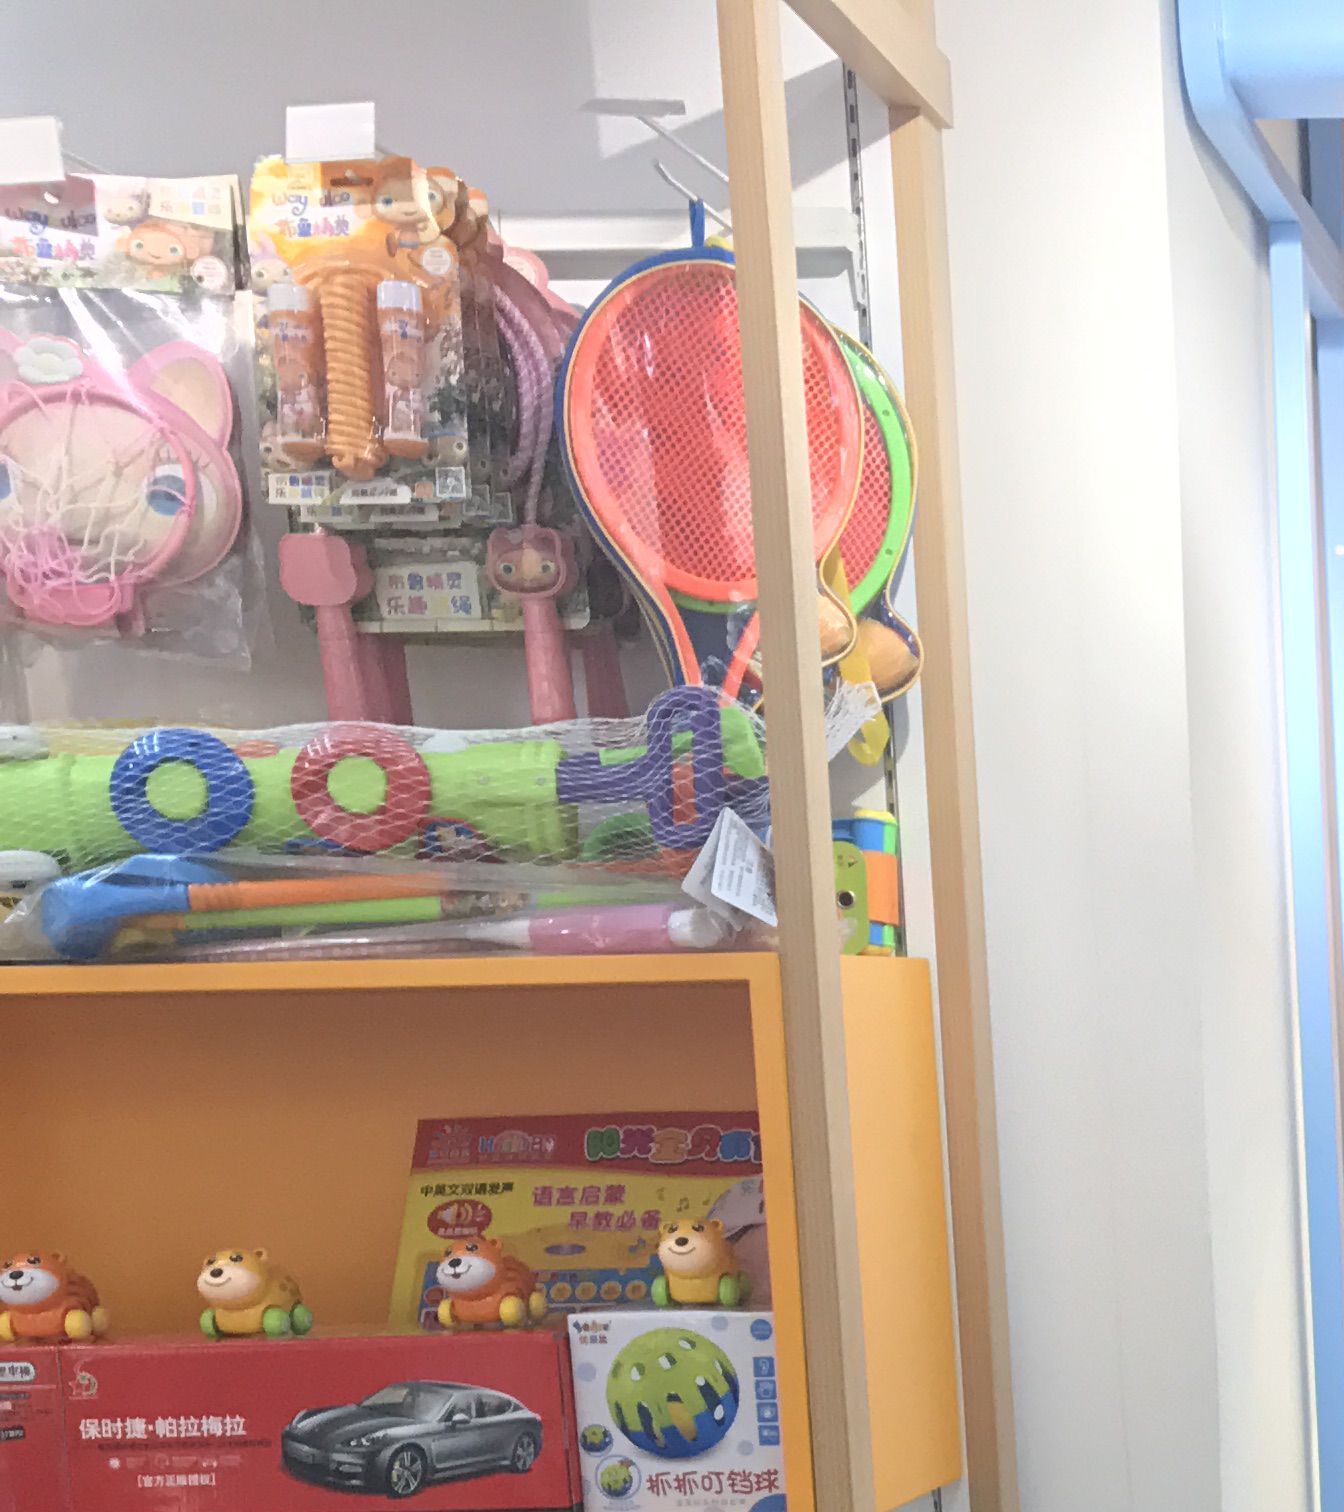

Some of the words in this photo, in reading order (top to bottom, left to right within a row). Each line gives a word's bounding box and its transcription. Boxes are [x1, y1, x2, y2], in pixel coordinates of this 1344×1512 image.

[532, 1184, 627, 1208] 语言启蒙
[79, 1414, 248, 1439] 保时捷·帕拉梅拉
